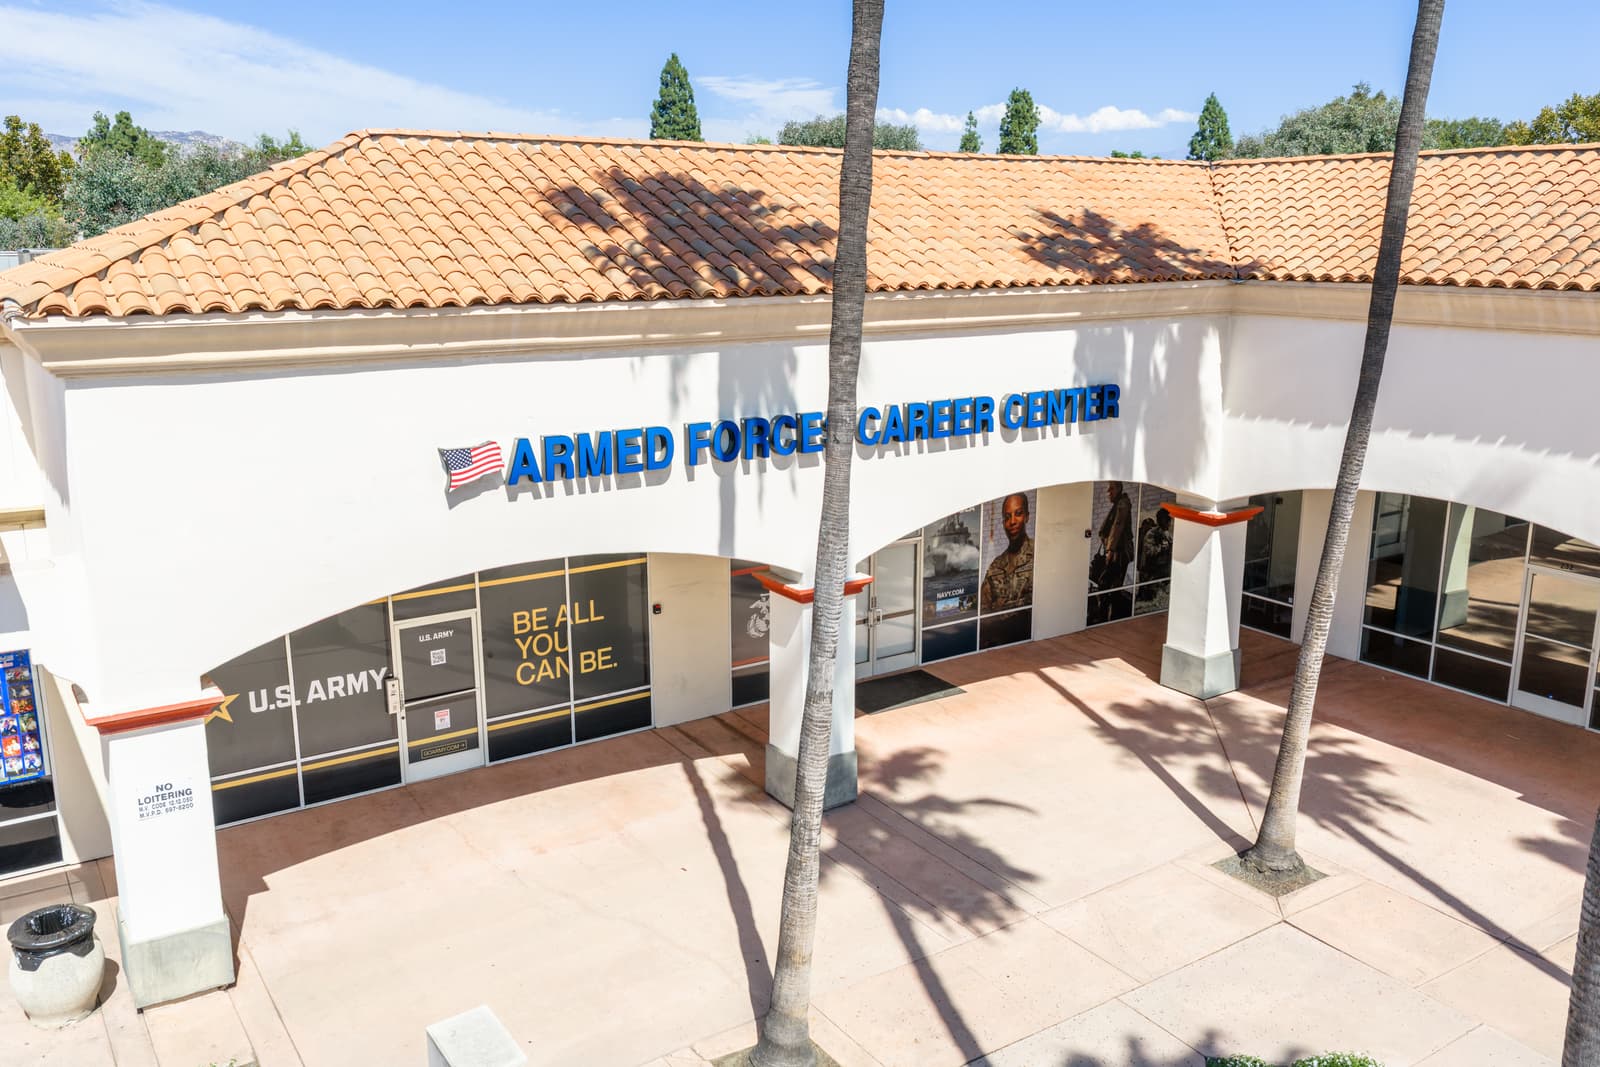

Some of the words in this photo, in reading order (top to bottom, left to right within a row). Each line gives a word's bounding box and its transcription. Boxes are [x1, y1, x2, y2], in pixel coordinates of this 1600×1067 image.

[507, 426, 675, 486] ARMED
[684, 411, 829, 466] FORCE
[857, 396, 995, 446] CAREER
[1001, 384, 1120, 430] CENTER
[936, 588, 965, 599] NAVY.COM
[512, 607, 549, 635] BE
[555, 599, 605, 628] ALL
[418, 634, 432, 642] U.S.
[433, 629, 454, 640] ARMY
[514, 631, 569, 660] YOU
[516, 656, 571, 686] CAN
[579, 646, 618, 674] BE.
[248, 685, 301, 714] U.S.
[306, 666, 388, 704] ARMY
[137, 788, 193, 806] LOITERING
[156, 783, 173, 792] NO
[151, 801, 167, 810] CODE
